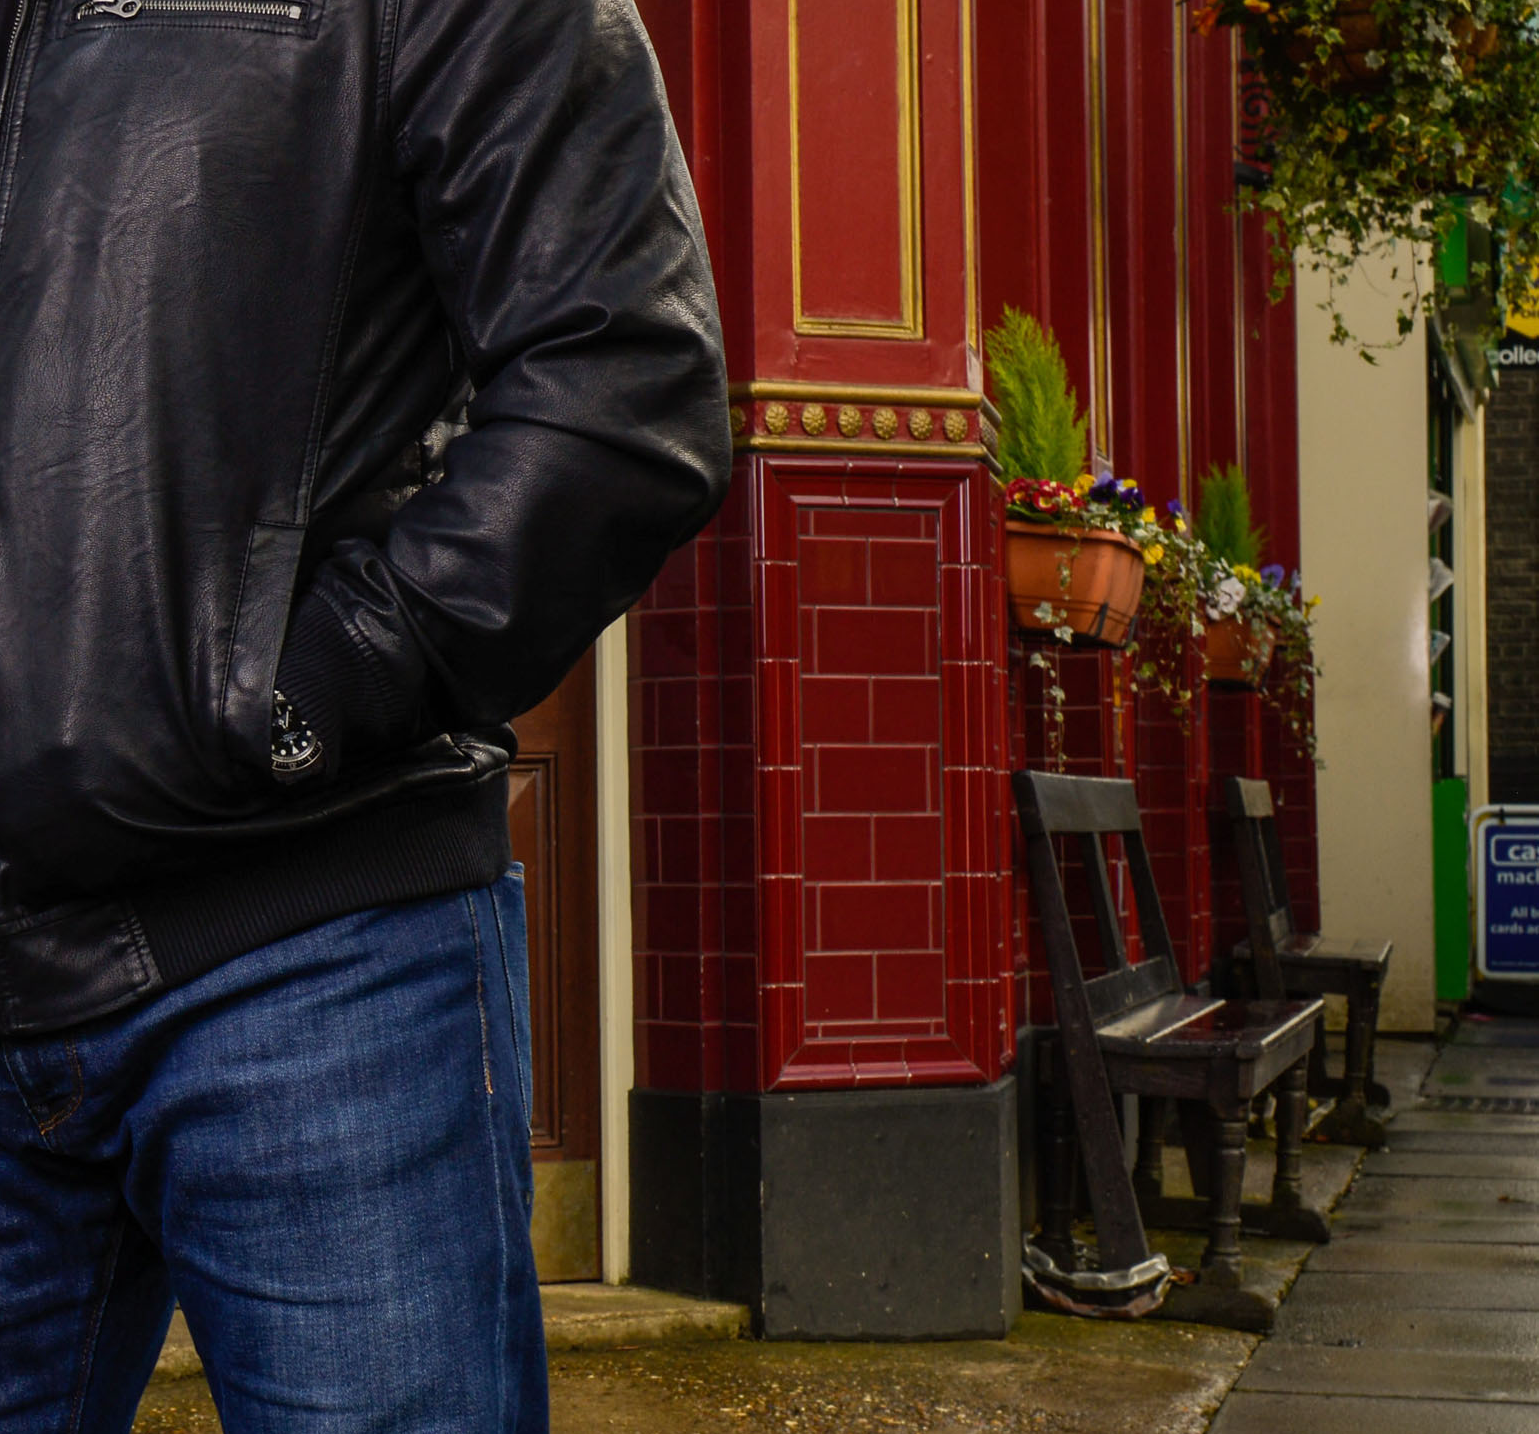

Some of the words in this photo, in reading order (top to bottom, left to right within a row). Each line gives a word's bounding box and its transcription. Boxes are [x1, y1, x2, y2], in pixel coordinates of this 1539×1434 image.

[1486, 345, 1539, 366] colle
[1507, 843, 1539, 862] ca
[1510, 906, 1529, 918] All
[1490, 922, 1524, 935] cards
